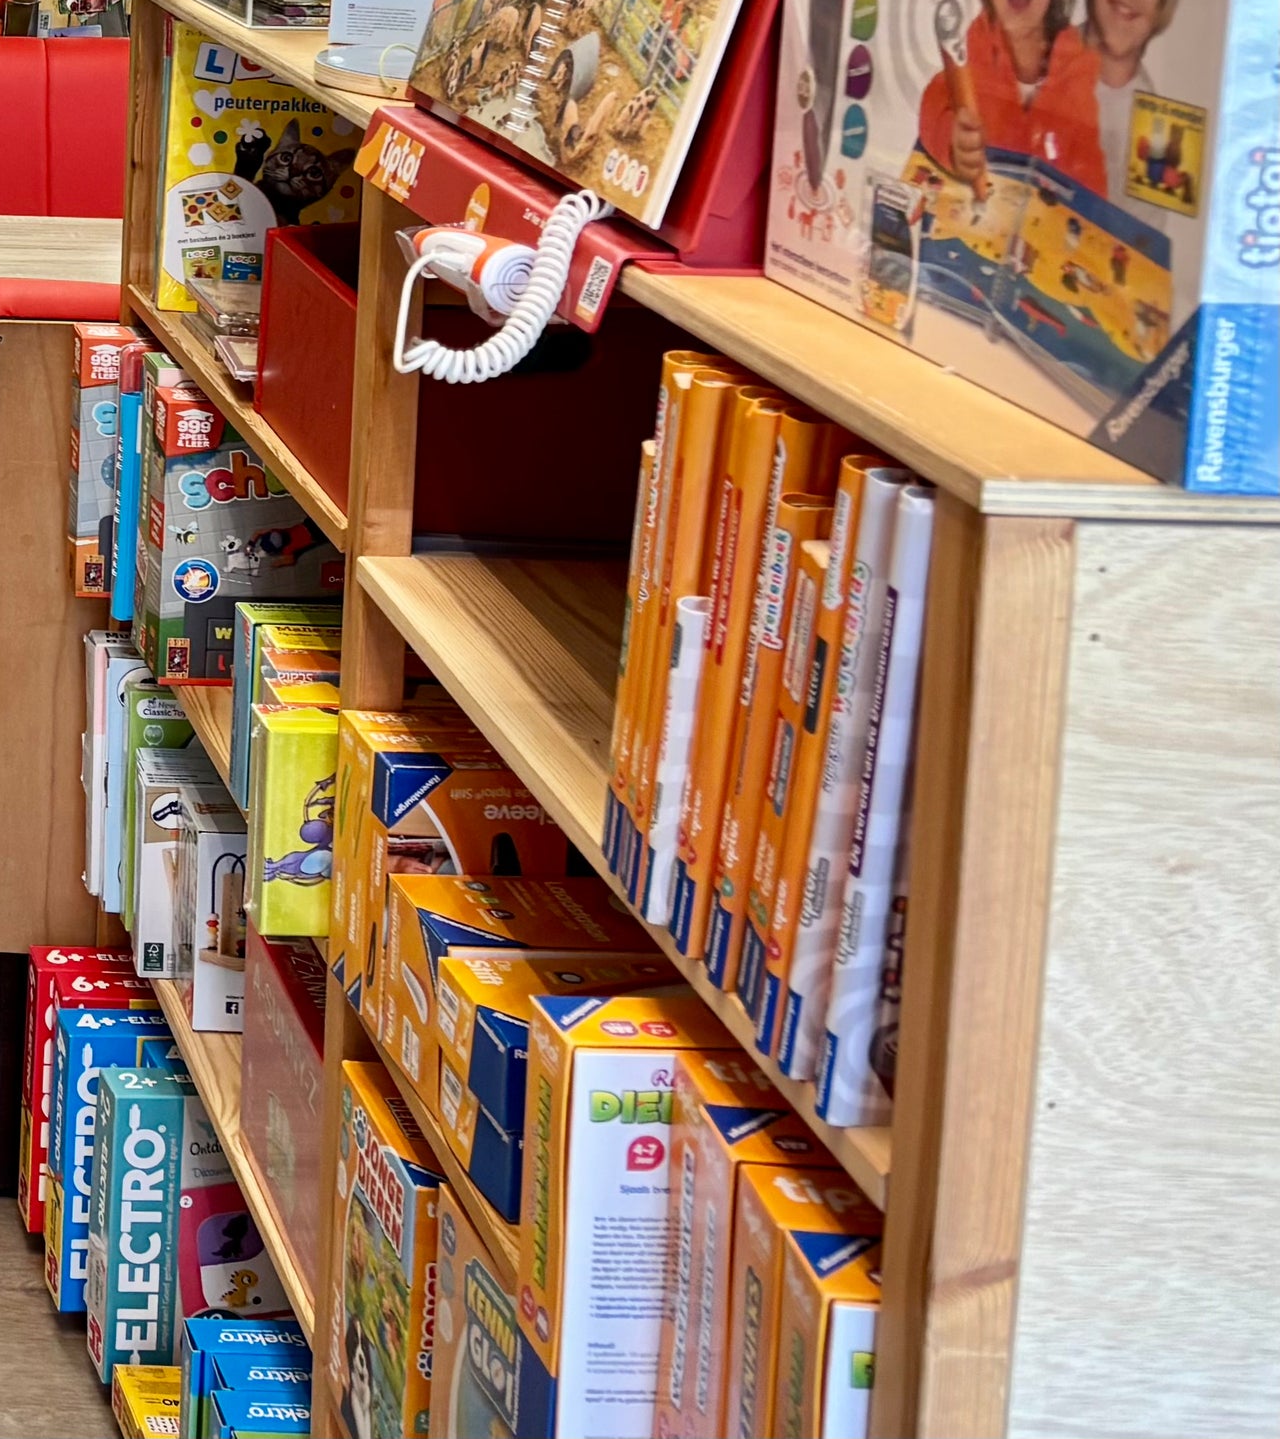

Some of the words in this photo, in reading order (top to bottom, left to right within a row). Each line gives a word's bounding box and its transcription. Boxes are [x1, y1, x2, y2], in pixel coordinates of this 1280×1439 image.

[214, 94, 328, 114] peuterpakket
[379, 122, 426, 190] tiptoi
[1197, 318, 1242, 483] Ravensburger
[176, 419, 212, 435] 999
[143, 709, 172, 717] Classic
[393, 775, 441, 817] Ravensburger
[45, 949, 85, 964] 6+
[72, 975, 111, 992] 6+
[76, 1013, 116, 1029] 4+
[120, 1072, 158, 1090] 2+
[365, 1127, 404, 1218] JONGE
[357, 1147, 403, 1259] DIEREN
[116, 1124, 167, 1354] ELECTRO
